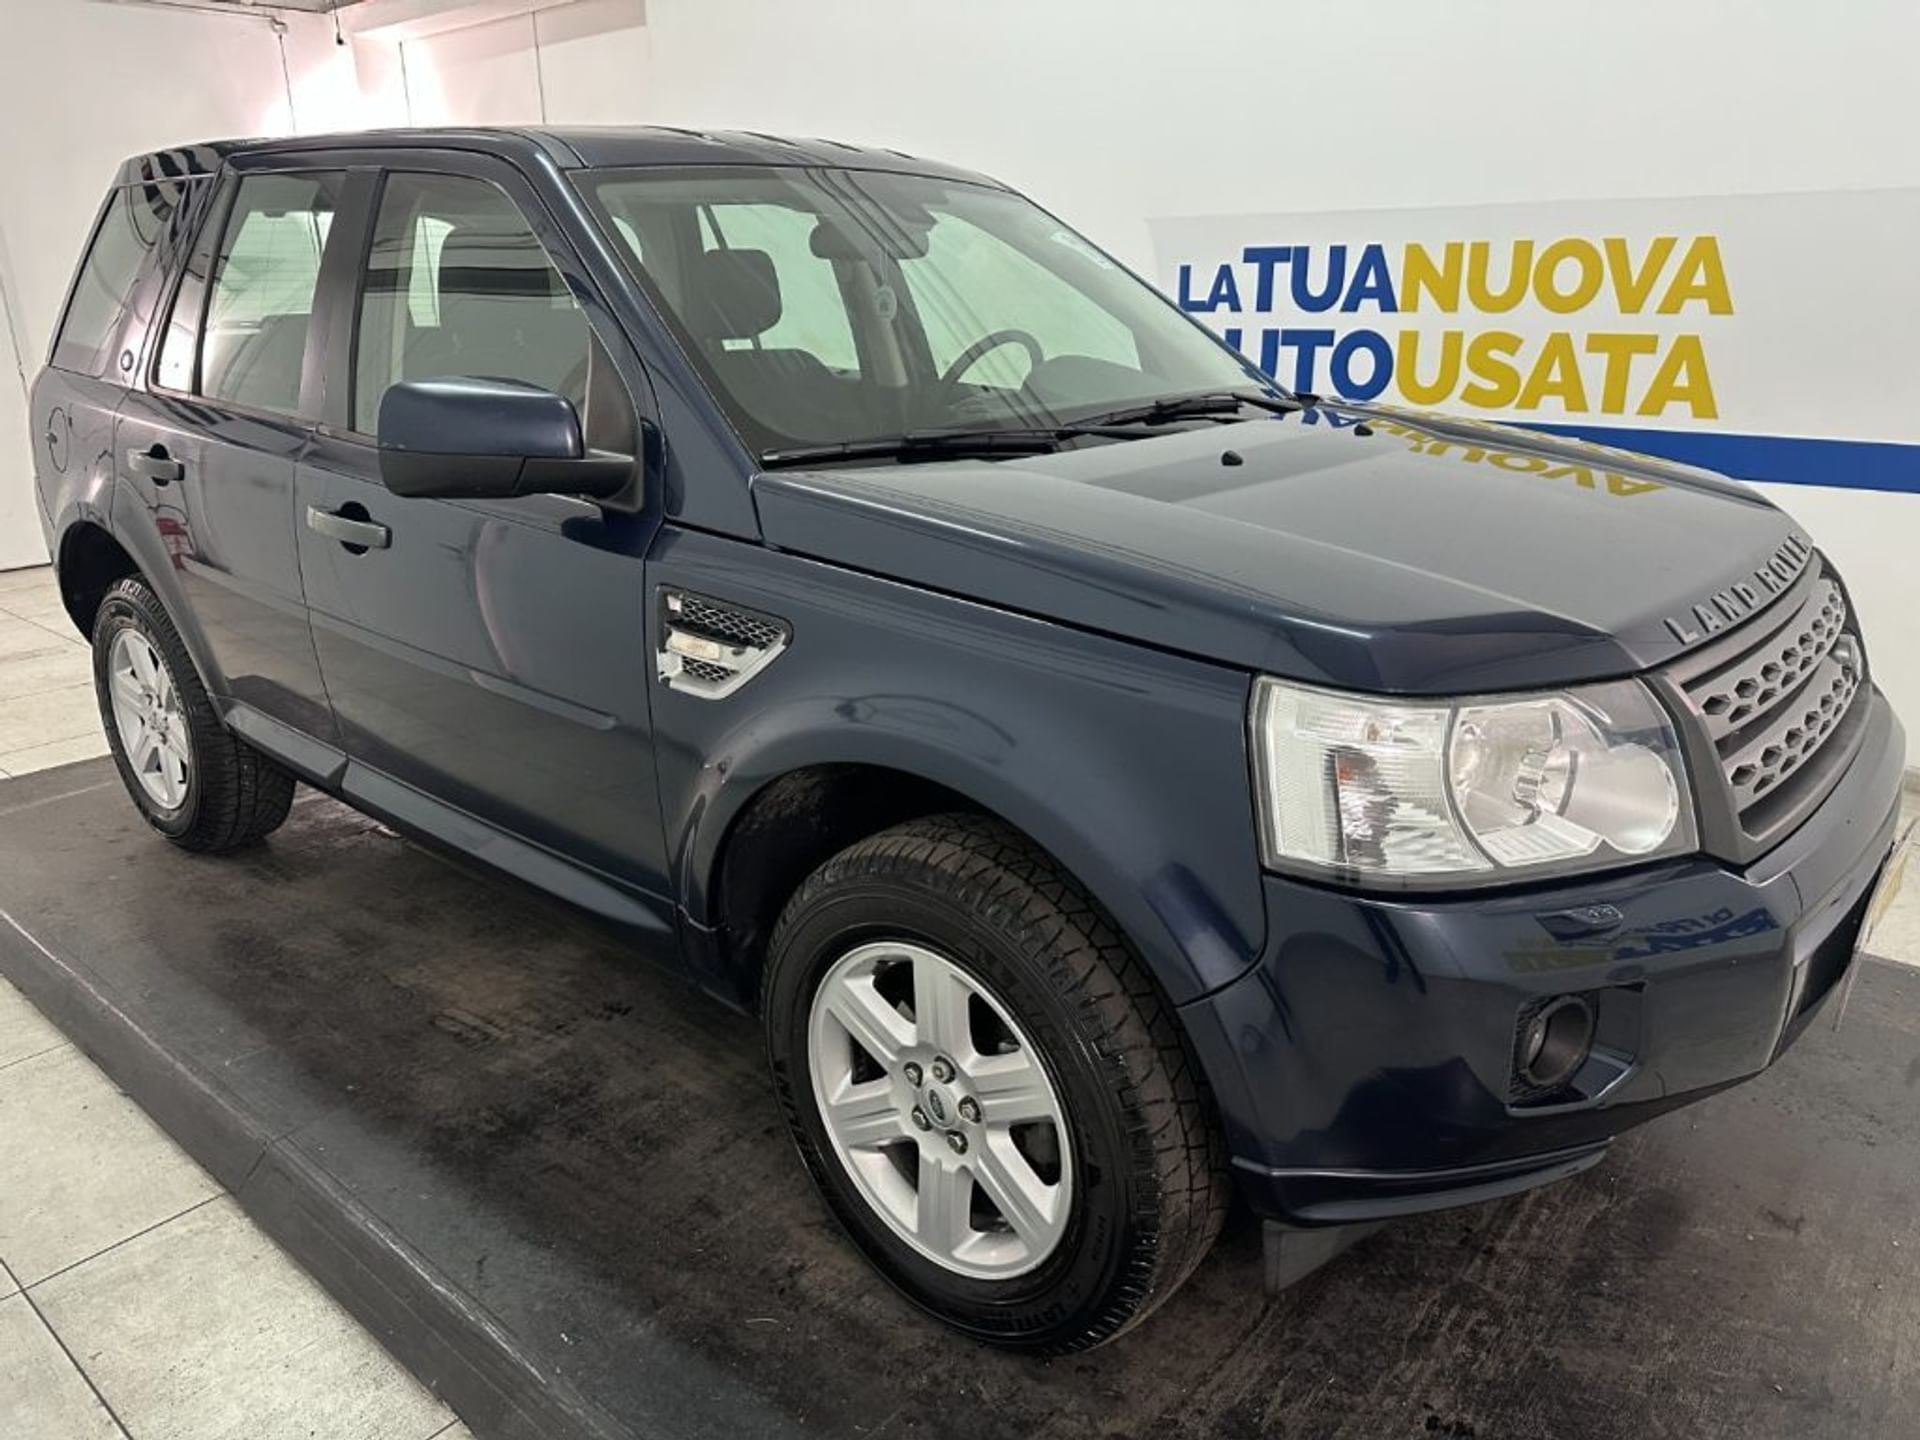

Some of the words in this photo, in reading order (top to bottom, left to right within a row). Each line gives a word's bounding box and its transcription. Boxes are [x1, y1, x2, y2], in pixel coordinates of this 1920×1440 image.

[1179, 264, 1240, 312] LA
[1242, 244, 1398, 313] TUA
[1399, 235, 1734, 315] NUOVA
[1224, 329, 1394, 402] UTO
[1396, 329, 1718, 420] USATA
[1663, 582, 1758, 646] LAND
